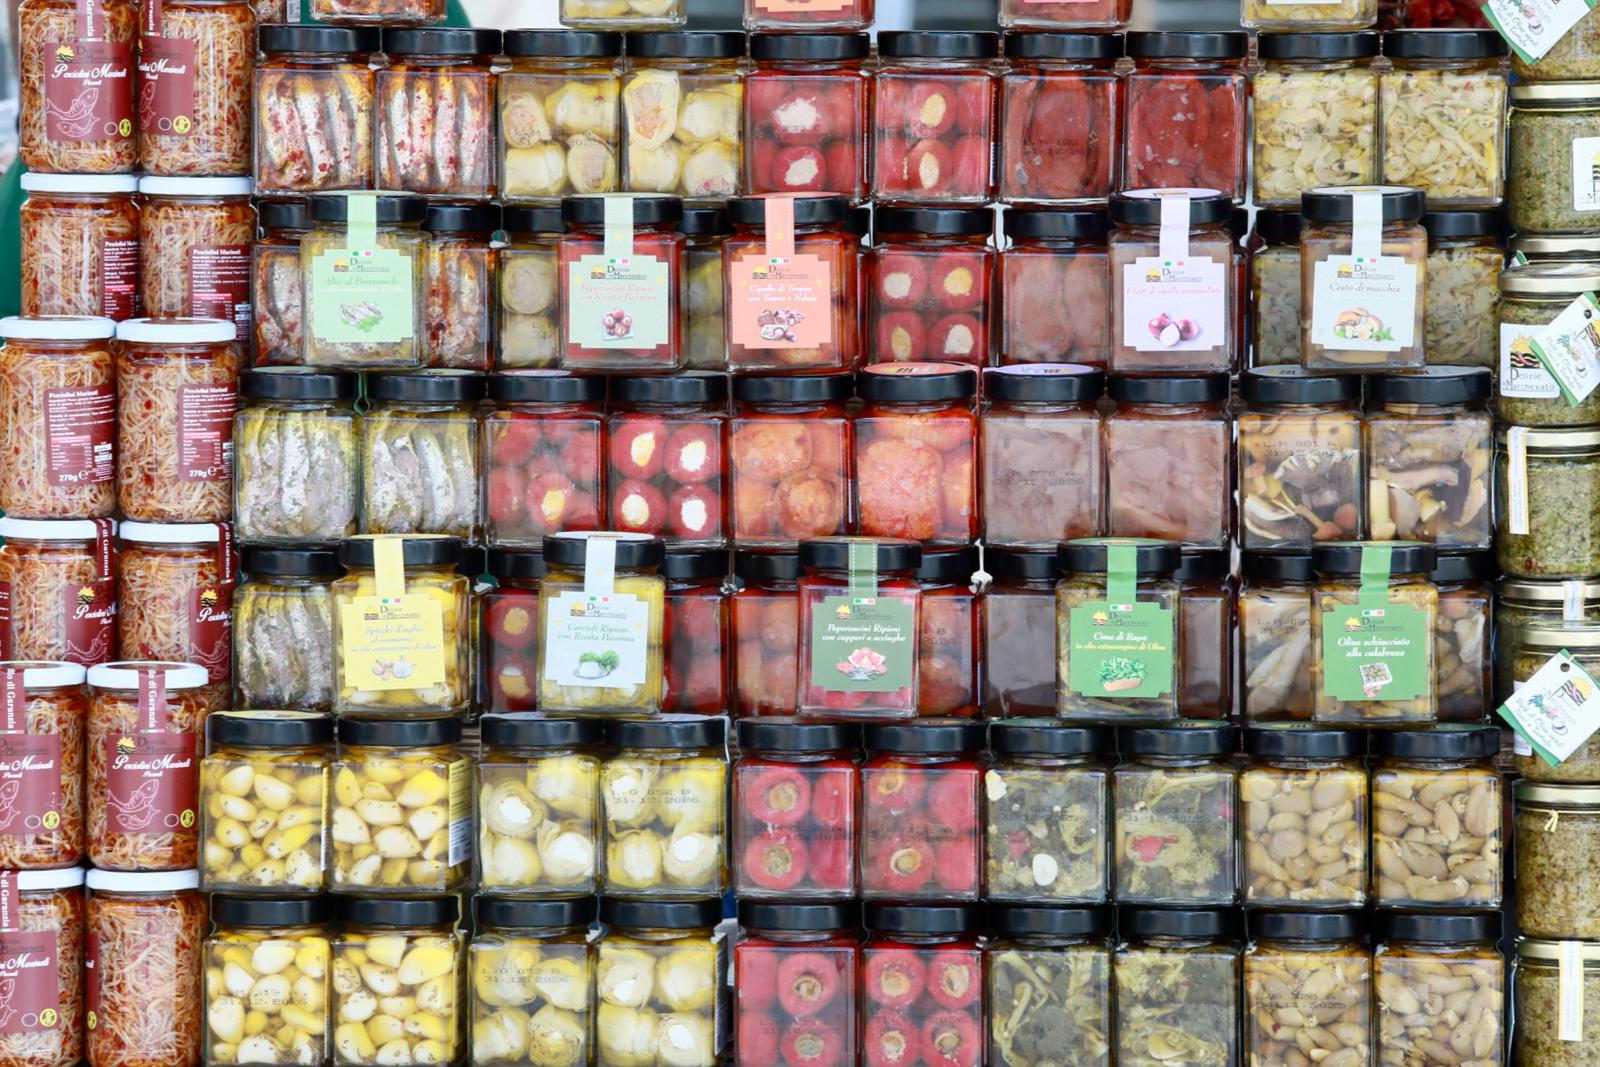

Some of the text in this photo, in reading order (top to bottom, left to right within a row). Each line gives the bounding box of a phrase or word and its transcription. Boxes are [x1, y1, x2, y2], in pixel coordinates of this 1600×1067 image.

[1330, 282, 1400, 292] Cesto di macchia
[1510, 368, 1541, 381] Delizie
[1506, 380, 1555, 391] Marchesato
[59, 473, 78, 482] 270g
[189, 469, 207, 478] 270g
[567, 623, 629, 633] Carciofi Ripieni
[827, 624, 901, 634] Peperoncini Ripieni
[574, 632, 599, 641] Ricotta
[836, 634, 865, 643] capperi
[873, 633, 906, 643] acciughe
[1093, 631, 1148, 642] Cime di Rapa
[1337, 635, 1410, 646] Olive schiacciate
[1138, 642, 1146, 650] di
[1346, 647, 1405, 657] alla calabrese
[7, 691, 16, 729] Garanzia
[148, 690, 157, 728] Garanzia
[1, 889, 10, 928] Garanzia
